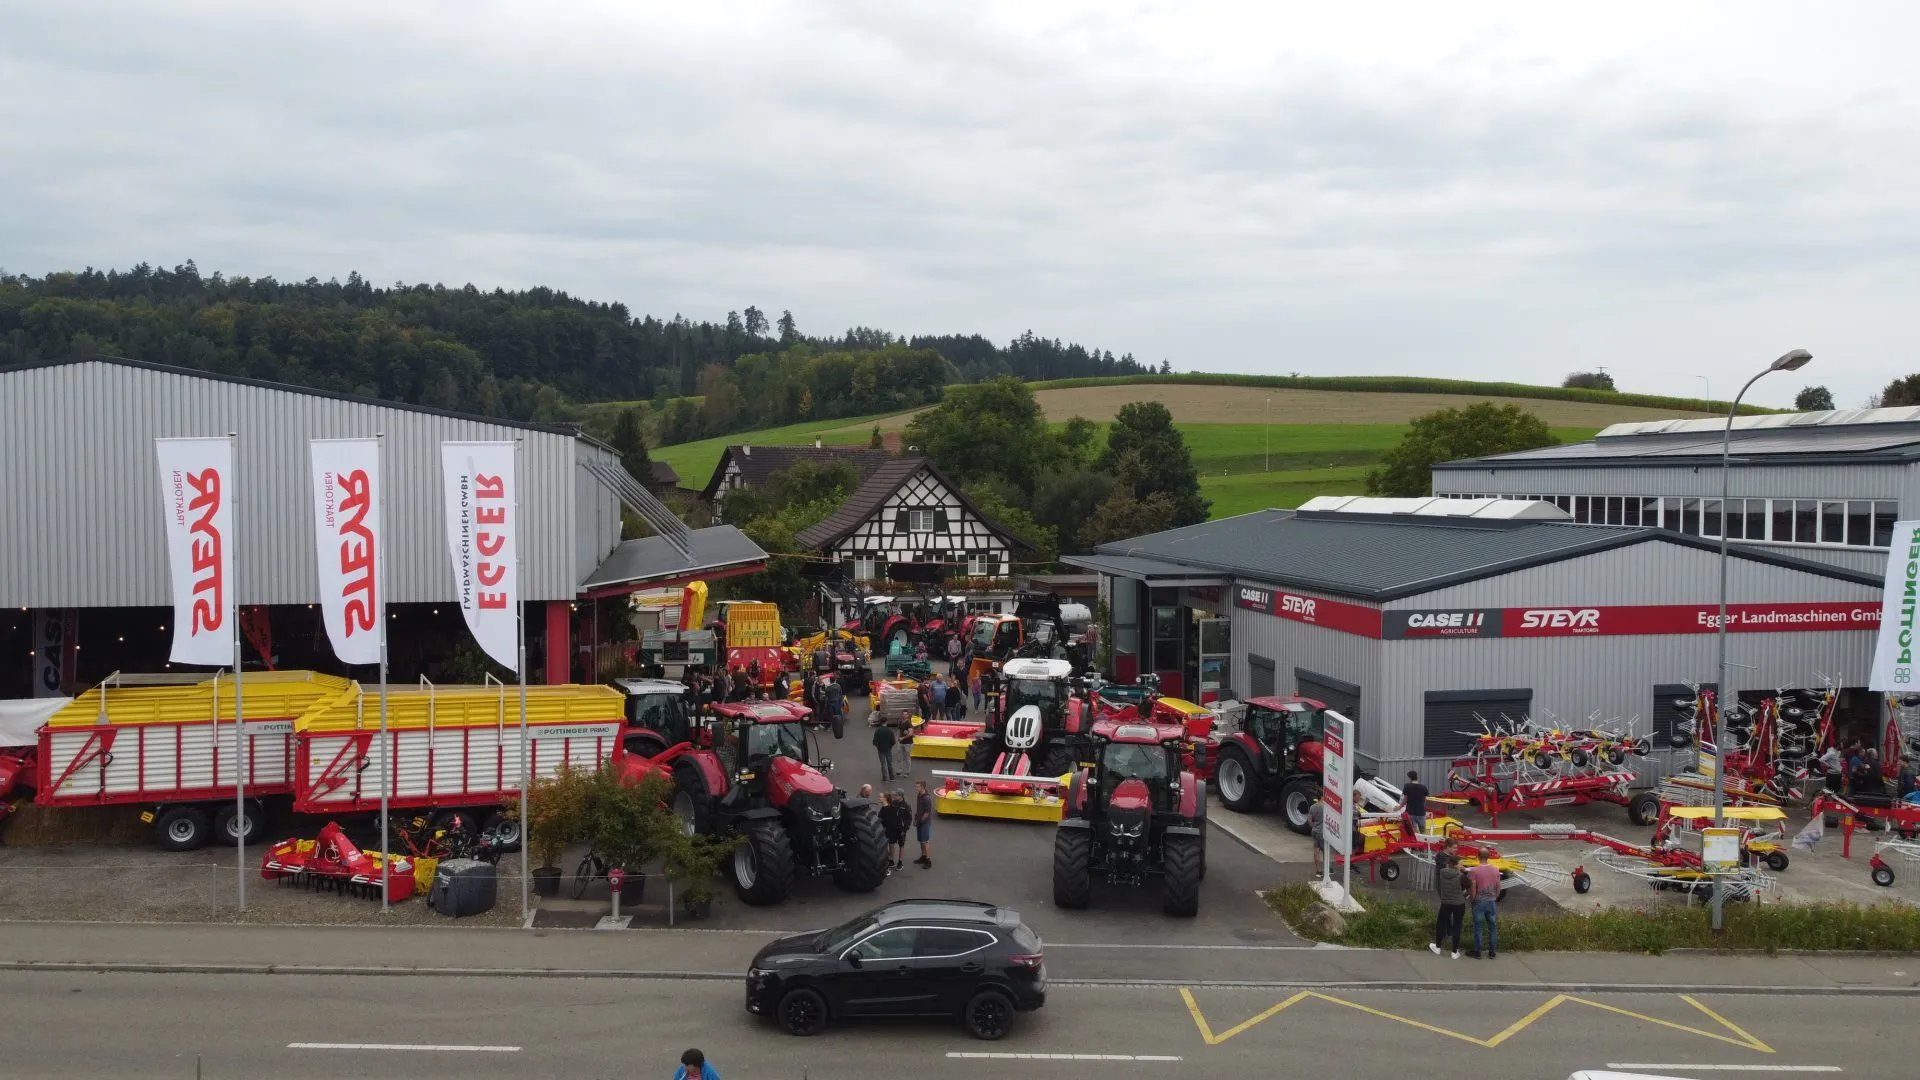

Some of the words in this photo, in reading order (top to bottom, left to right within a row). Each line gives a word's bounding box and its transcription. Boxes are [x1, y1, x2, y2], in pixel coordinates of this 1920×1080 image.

[1241, 588, 1261, 602] CASE
[1281, 595, 1316, 616] STEYR
[1408, 613, 1464, 627] CASE
[1520, 609, 1600, 628] STEYR
[1742, 609, 1847, 624] Landmaschinen
[1851, 608, 1883, 621] Gmb
